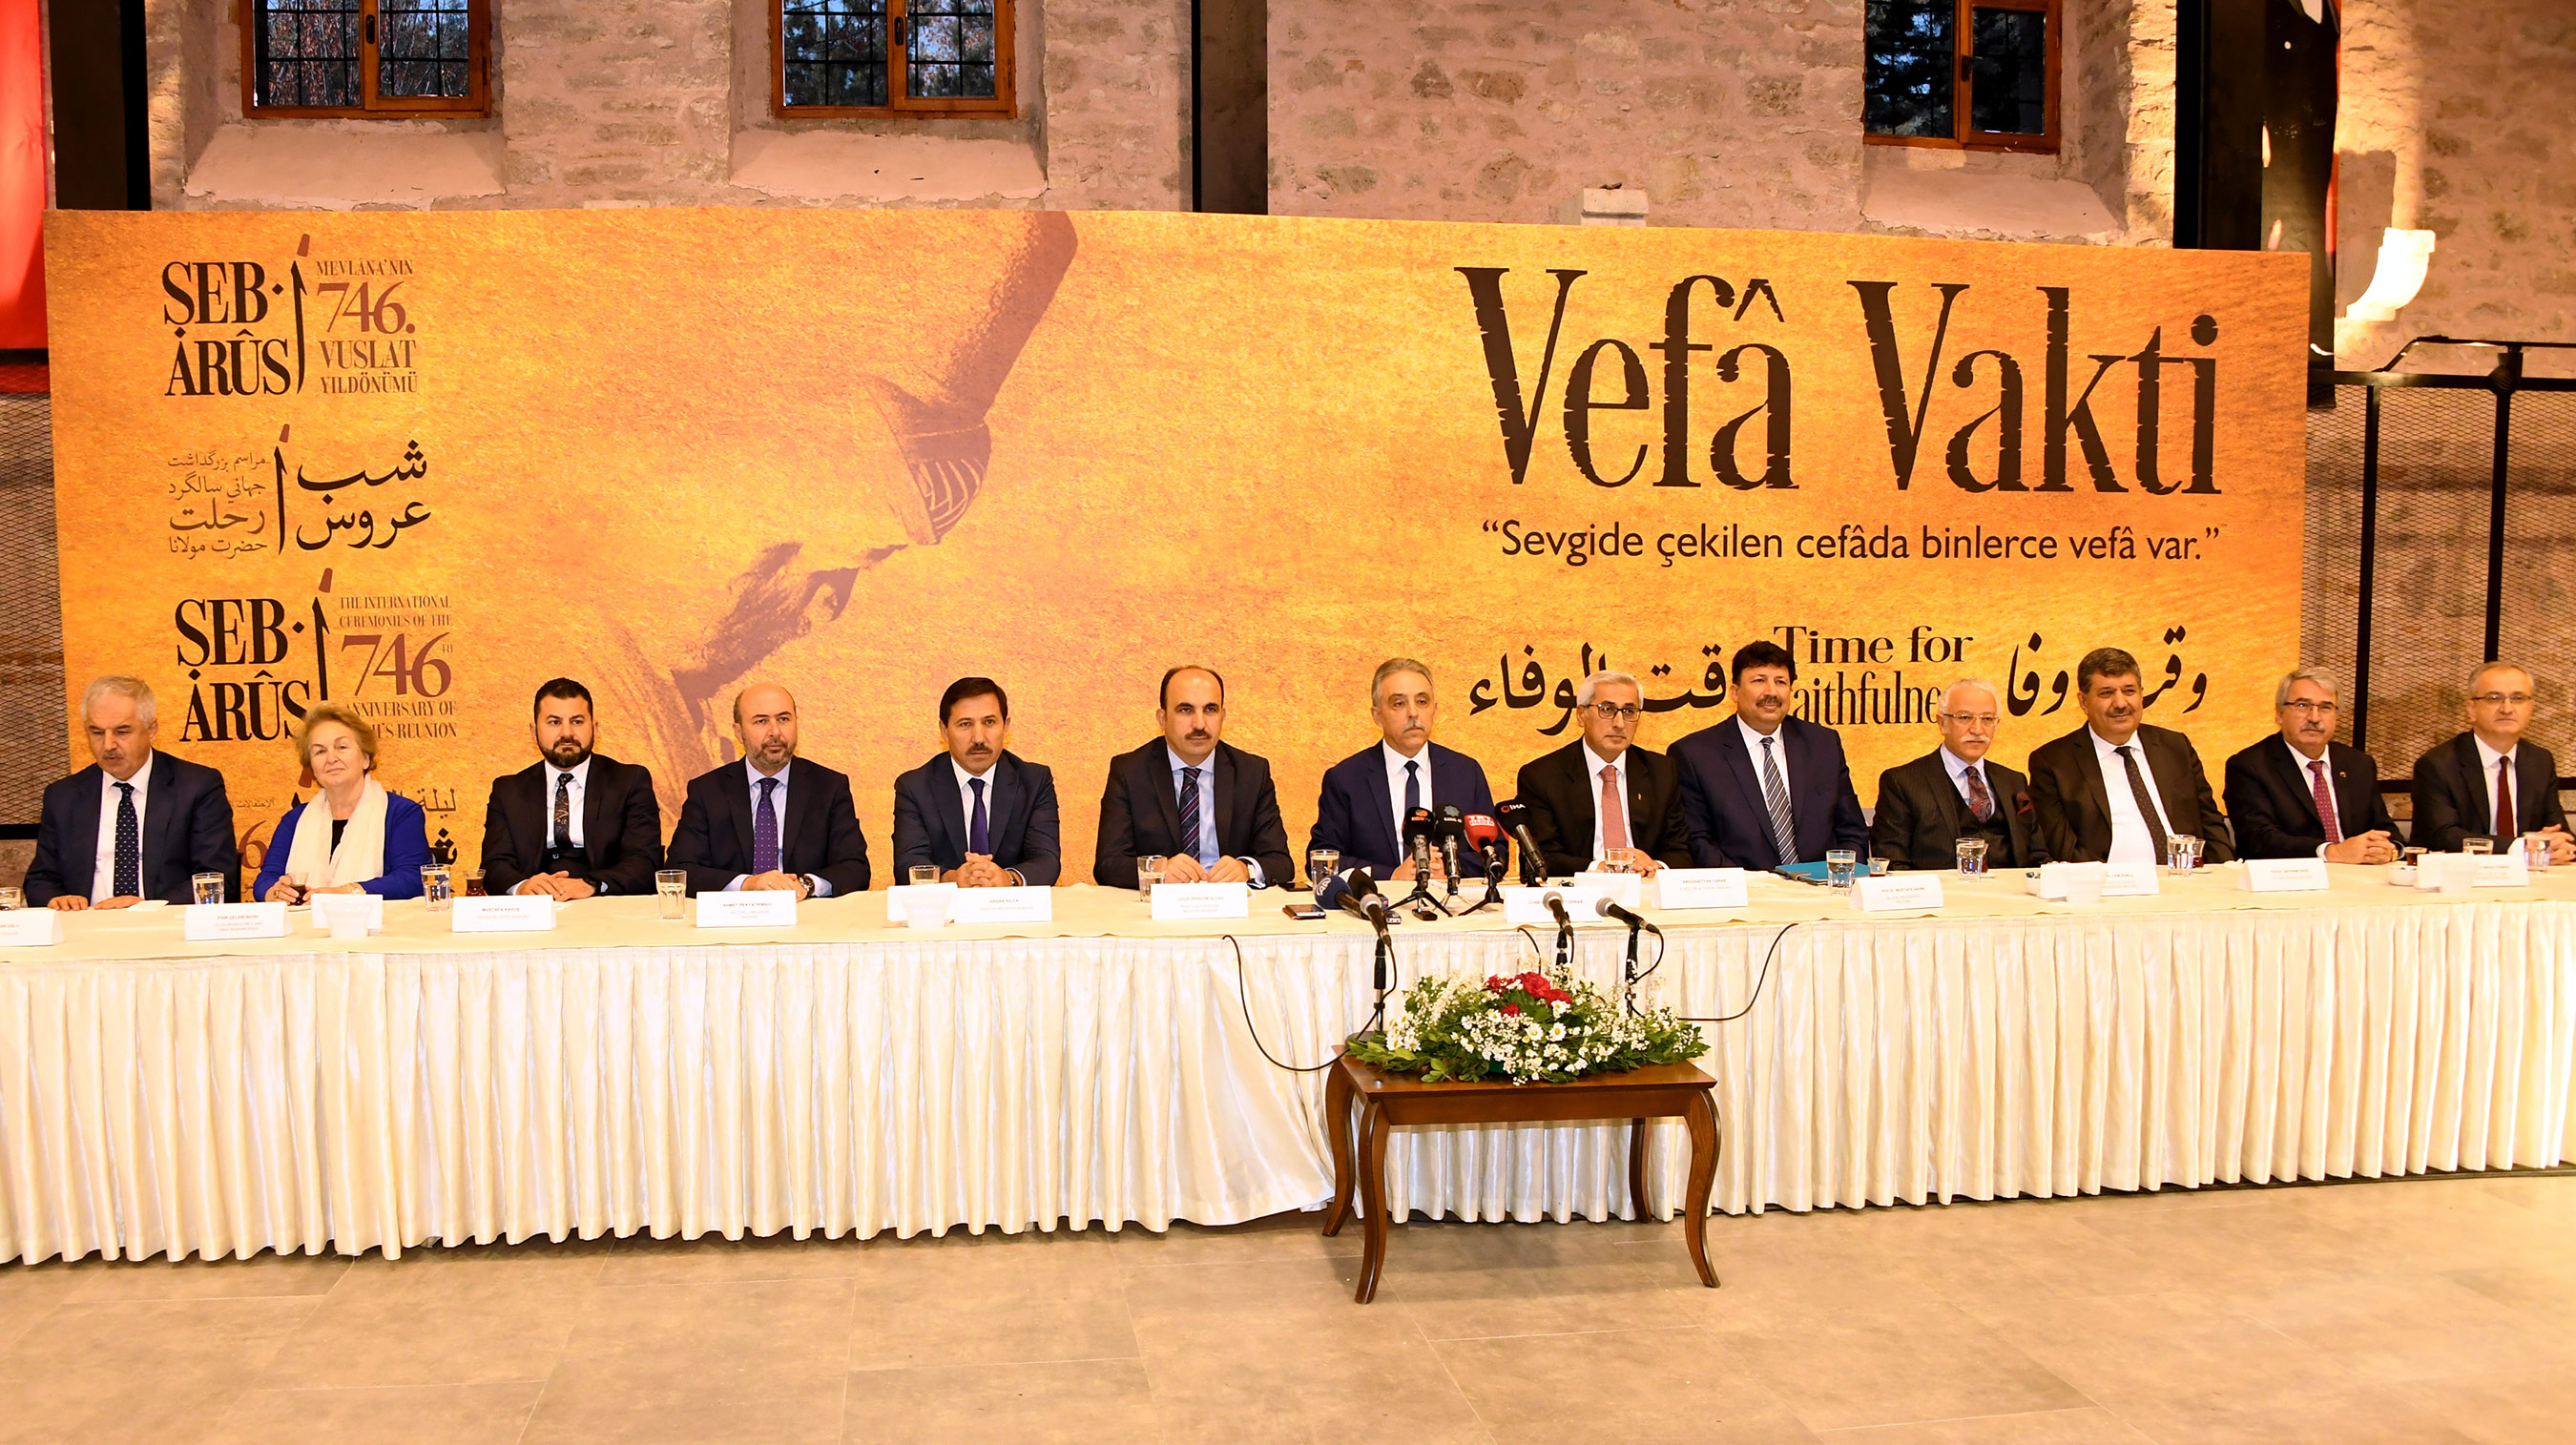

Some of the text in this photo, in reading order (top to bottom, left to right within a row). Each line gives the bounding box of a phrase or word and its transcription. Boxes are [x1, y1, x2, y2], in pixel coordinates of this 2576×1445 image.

[316, 279, 416, 334] 746.
[164, 328, 291, 397] ARÛS
[319, 339, 417, 370] VUSLAT
[320, 371, 418, 394] YILDÖNÜMÜ
[1454, 266, 2222, 495] Vefâ Vakti
[169, 497, 265, 534] رحلت
[1482, 518, 1644, 567] “Sevgide
[1655, 523, 1783, 568] çekilen
[1796, 523, 1910, 559] cefâda
[1922, 525, 2058, 559] binlerce
[2068, 525, 2136, 560] vefâ
[339, 613, 452, 628] CEREMONIES OF THE
[364, 595, 452, 609] INTERNATIONAL
[1773, 625, 1974, 664] Time for
[438, 700, 457, 716] OF
[1792, 670, 1942, 726] aithfulne
